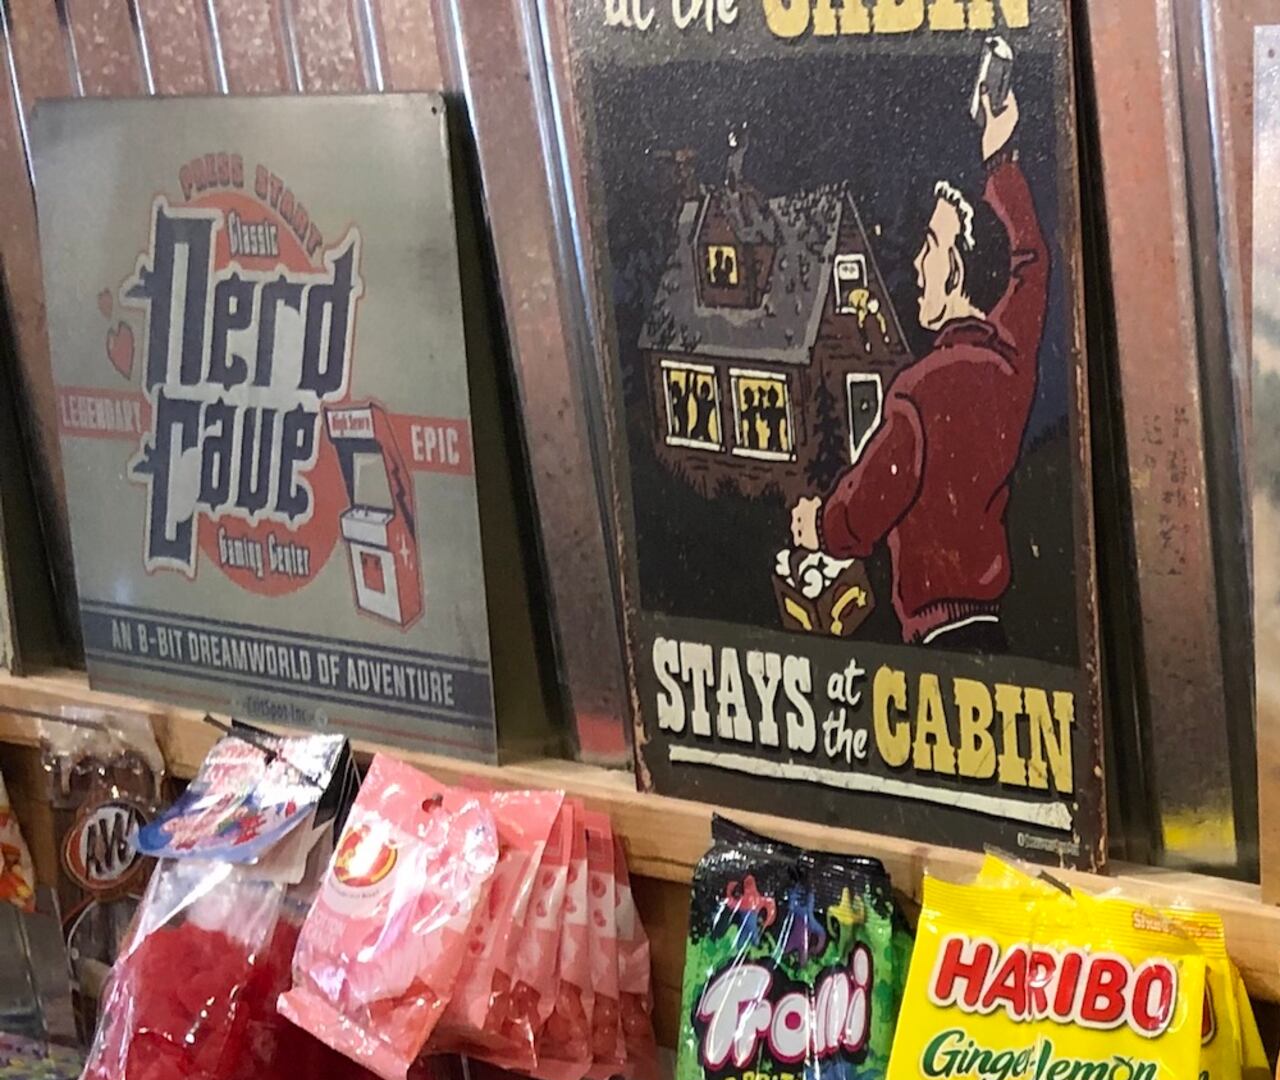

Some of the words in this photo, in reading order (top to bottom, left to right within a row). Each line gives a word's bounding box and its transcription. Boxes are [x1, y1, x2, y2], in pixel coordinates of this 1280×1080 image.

[227, 208, 279, 258] Classic
[254, 164, 323, 258] START
[125, 202, 357, 399] Nerd
[411, 424, 461, 465] EPIC
[217, 527, 264, 580] Gaming
[267, 534, 311, 578] Center
[111, 619, 133, 650] AN
[138, 627, 184, 661] 8-BIT
[188, 631, 312, 685] DREAMWORLD
[317, 655, 341, 685] OF
[346, 658, 455, 706] ADVENTURE
[652, 637, 818, 754] STAYS
[827, 658, 866, 705] at
[822, 706, 867, 760] the
[873, 664, 1076, 794] CABIN
[698, 946, 871, 1068] Trolli
[935, 936, 1178, 1034] HARIBO
